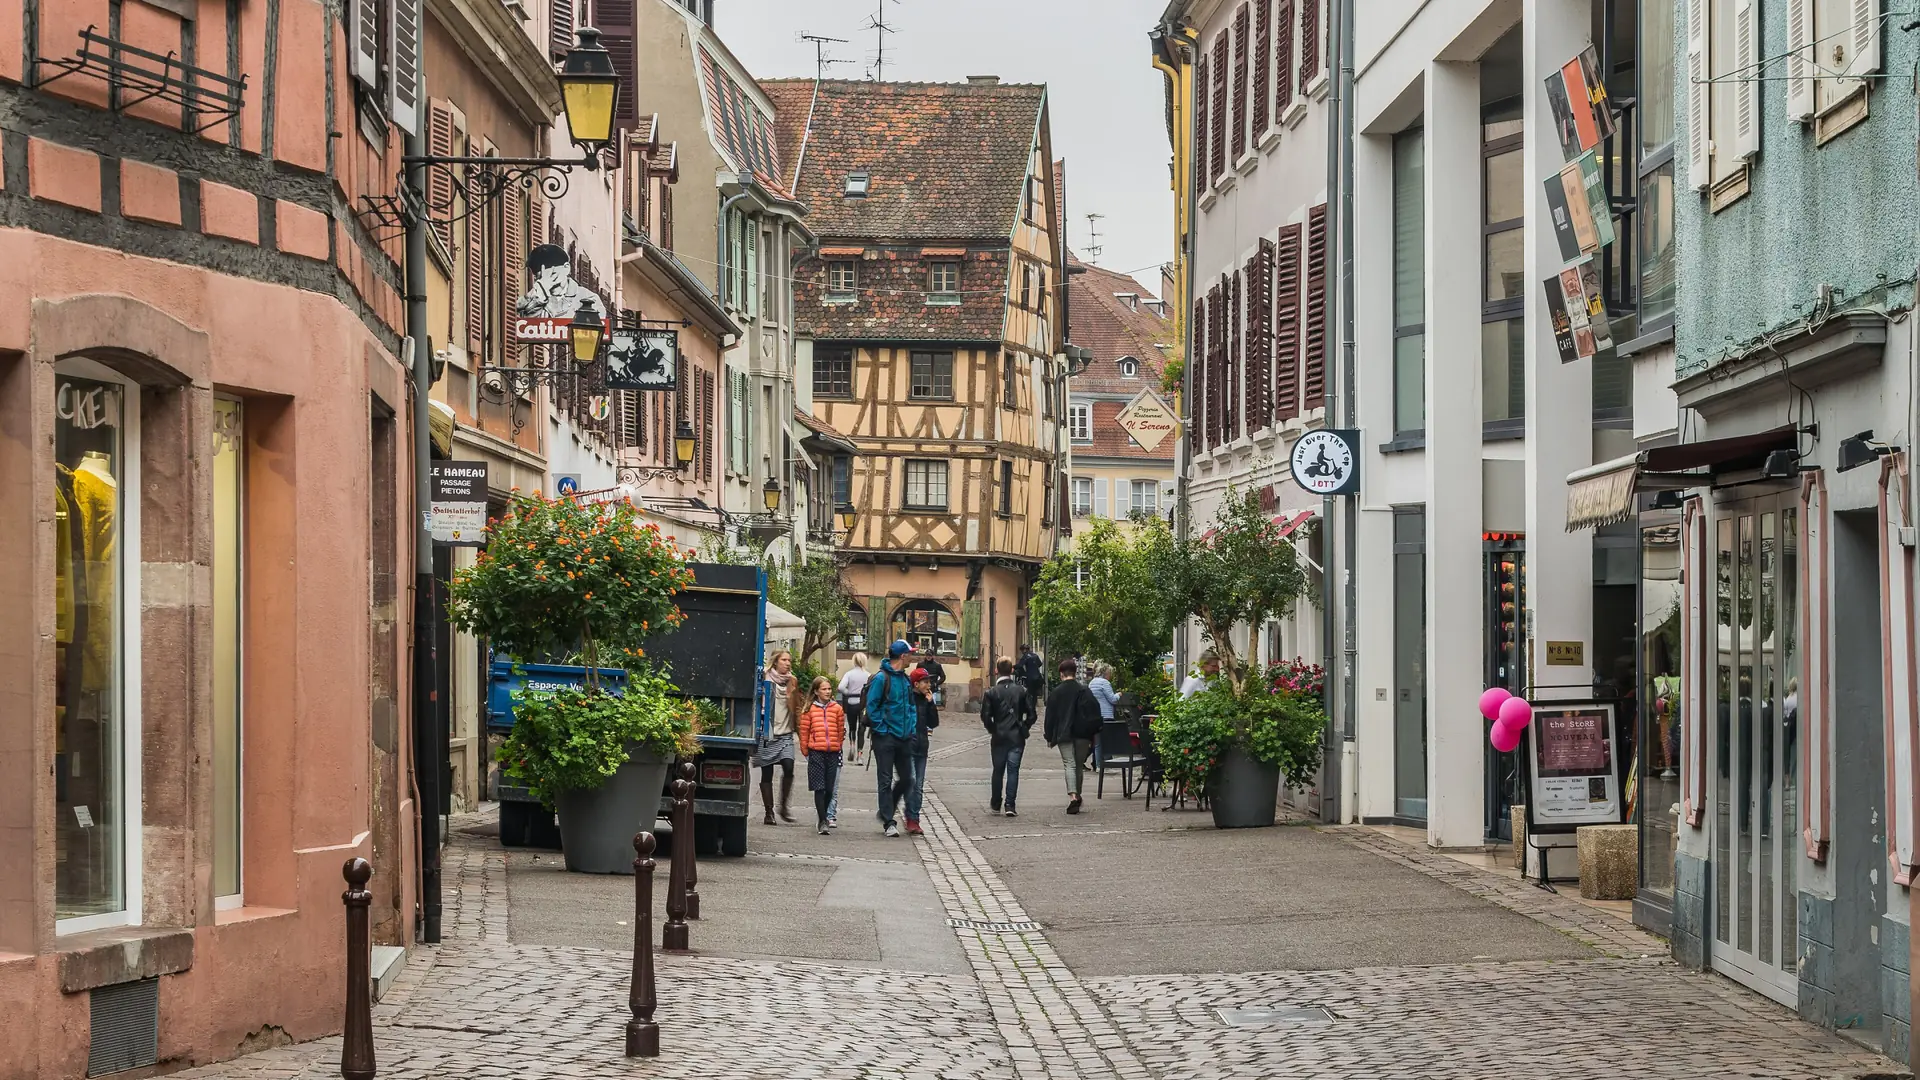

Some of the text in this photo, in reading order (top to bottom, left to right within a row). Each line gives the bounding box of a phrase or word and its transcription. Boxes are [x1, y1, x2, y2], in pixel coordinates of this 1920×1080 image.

[1137, 405, 1158, 413] Pizzeria
[1126, 420, 1170, 430] Il Sereno
[1295, 434, 1350, 466] Just Over The Top
[444, 468, 486, 478] HAMEAU
[440, 479, 471, 487] PASSAGE
[1311, 480, 1335, 488] JOTT
[441, 487, 471, 495] PIETONS
[1549, 721, 1565, 729] the
[1550, 733, 1595, 741] NOUVEAU
